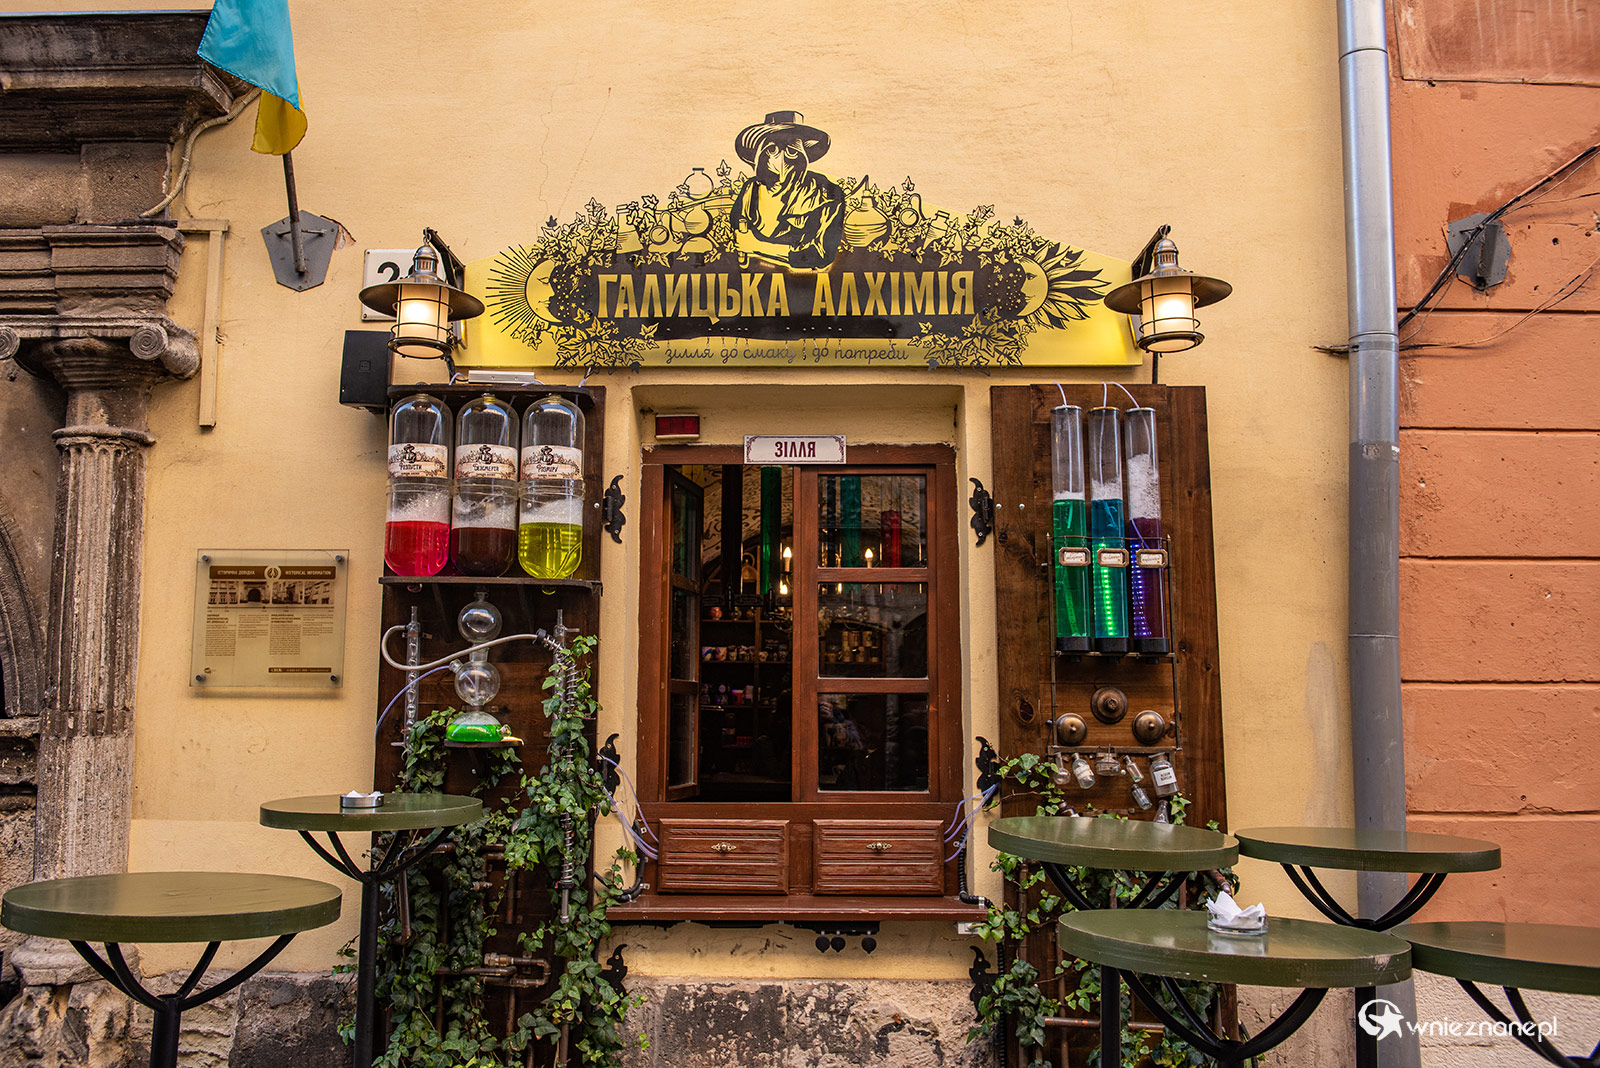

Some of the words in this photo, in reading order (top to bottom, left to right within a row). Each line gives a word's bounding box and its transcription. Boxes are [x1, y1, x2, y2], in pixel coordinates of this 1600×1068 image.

[597, 272, 791, 325] ГАЛИЦЬКА
[811, 270, 975, 317] АЛХІМІЯ
[665, 347, 714, 364] зілля
[720, 348, 738, 364] до
[743, 347, 797, 364] смаку
[812, 346, 830, 363] до
[834, 342, 909, 364] потреби
[774, 441, 816, 458] ЗІЛЛЯ
